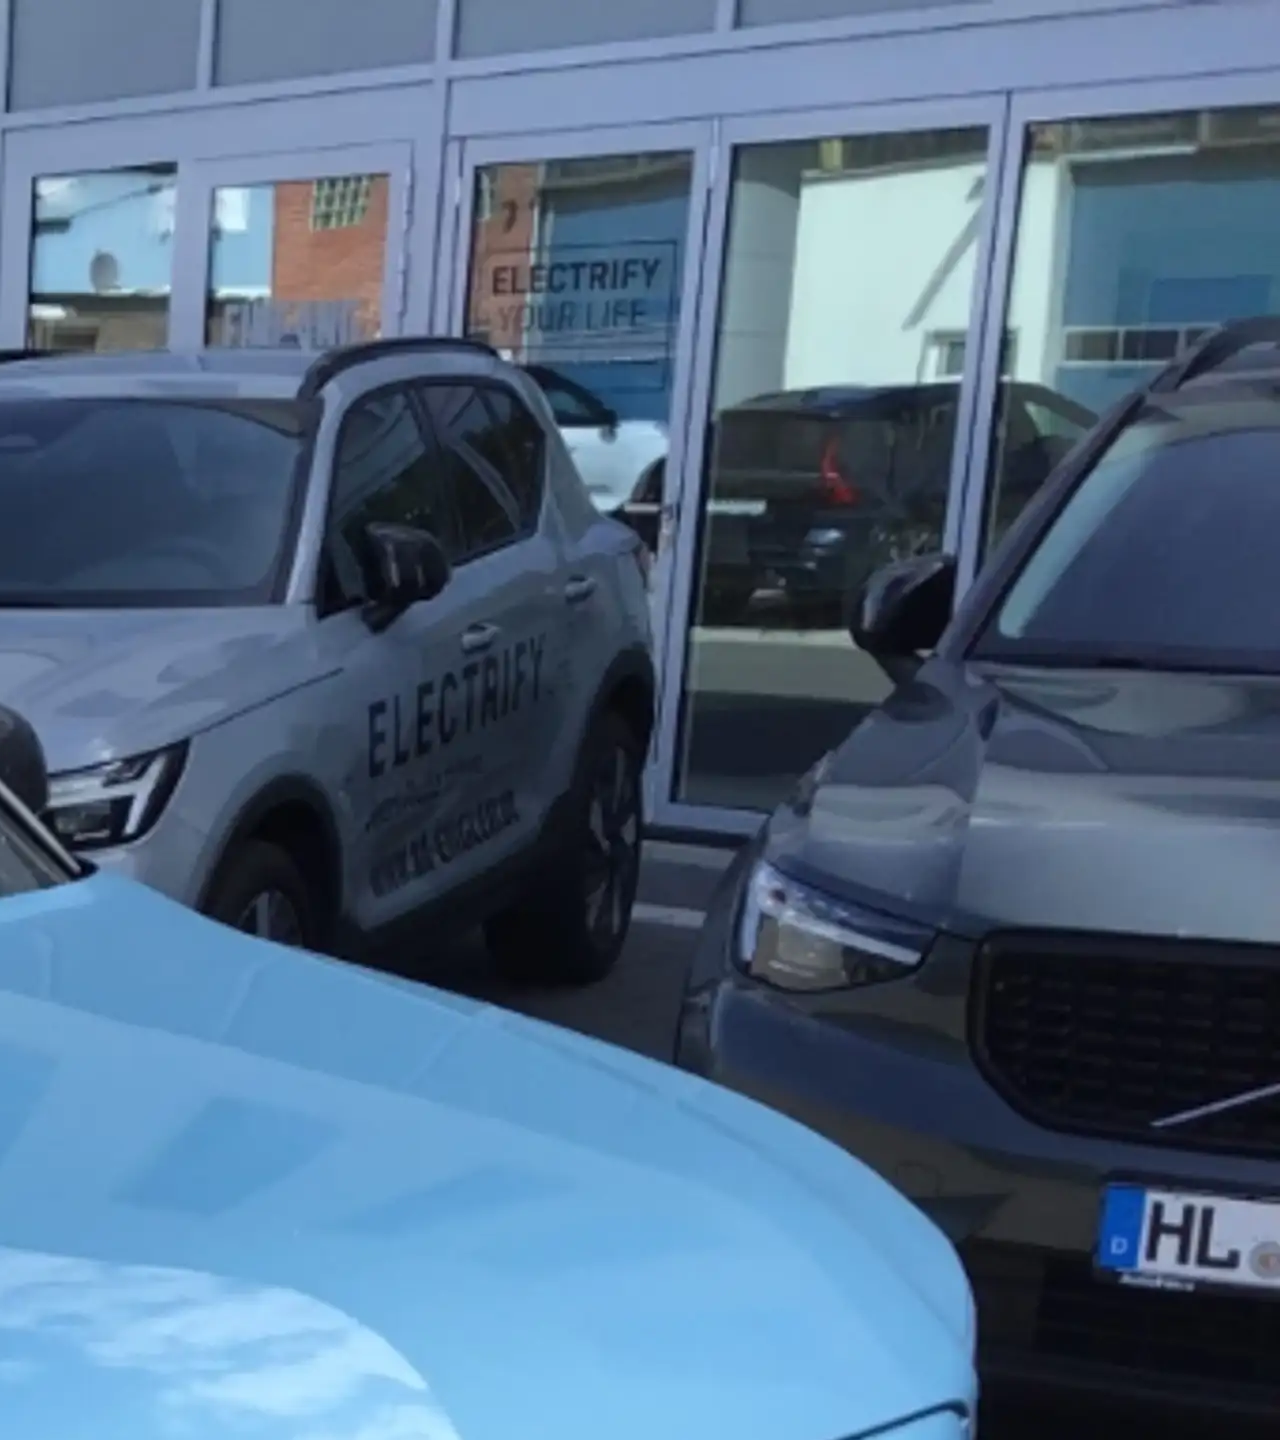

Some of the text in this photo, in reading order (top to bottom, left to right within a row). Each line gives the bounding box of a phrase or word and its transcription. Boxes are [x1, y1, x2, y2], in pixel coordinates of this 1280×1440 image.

[492, 257, 662, 297] ELECTRIFY
[497, 299, 649, 333] YOUR LIFE
[368, 632, 547, 779] ELECTRIFY
[1109, 1201, 1240, 1270] D HL
